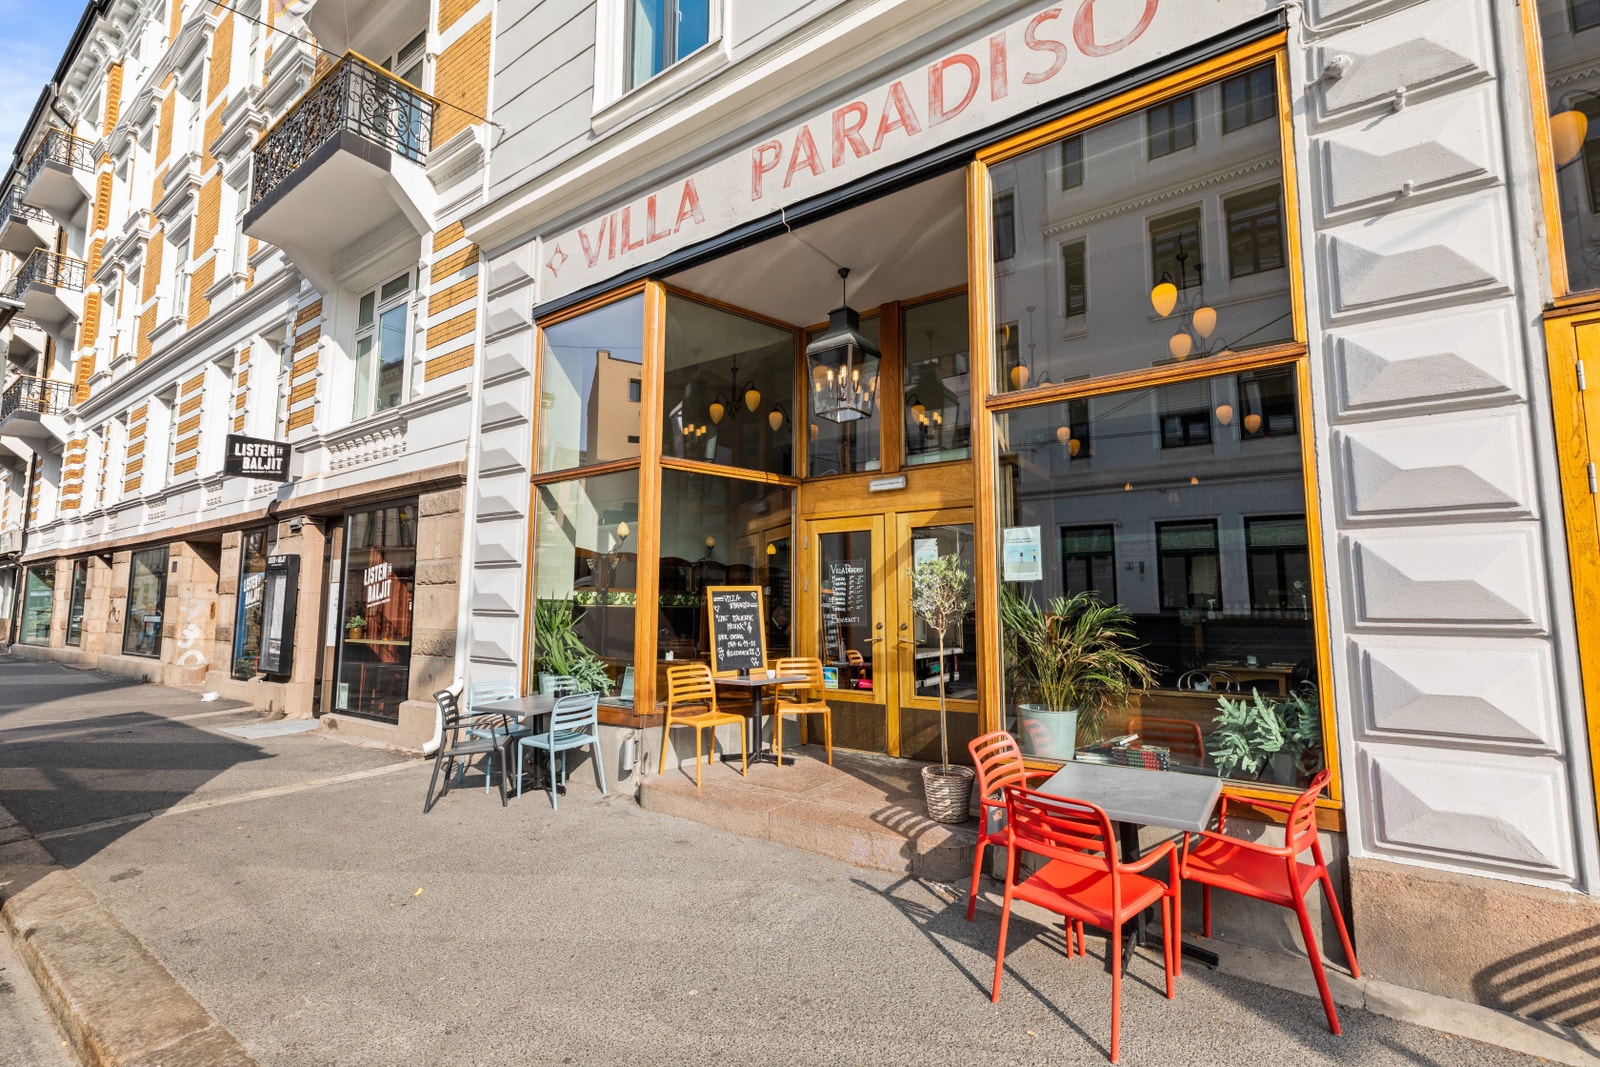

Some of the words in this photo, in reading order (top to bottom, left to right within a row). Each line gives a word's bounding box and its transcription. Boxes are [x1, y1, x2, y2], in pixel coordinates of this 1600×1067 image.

[578, 178, 705, 268] VILLA
[751, 0, 1159, 201] PARADISO
[235, 443, 275, 457] LISTEN
[242, 456, 283, 470] BALJIT
[363, 562, 387, 586] LISTEN
[367, 579, 391, 602] BALJIT
